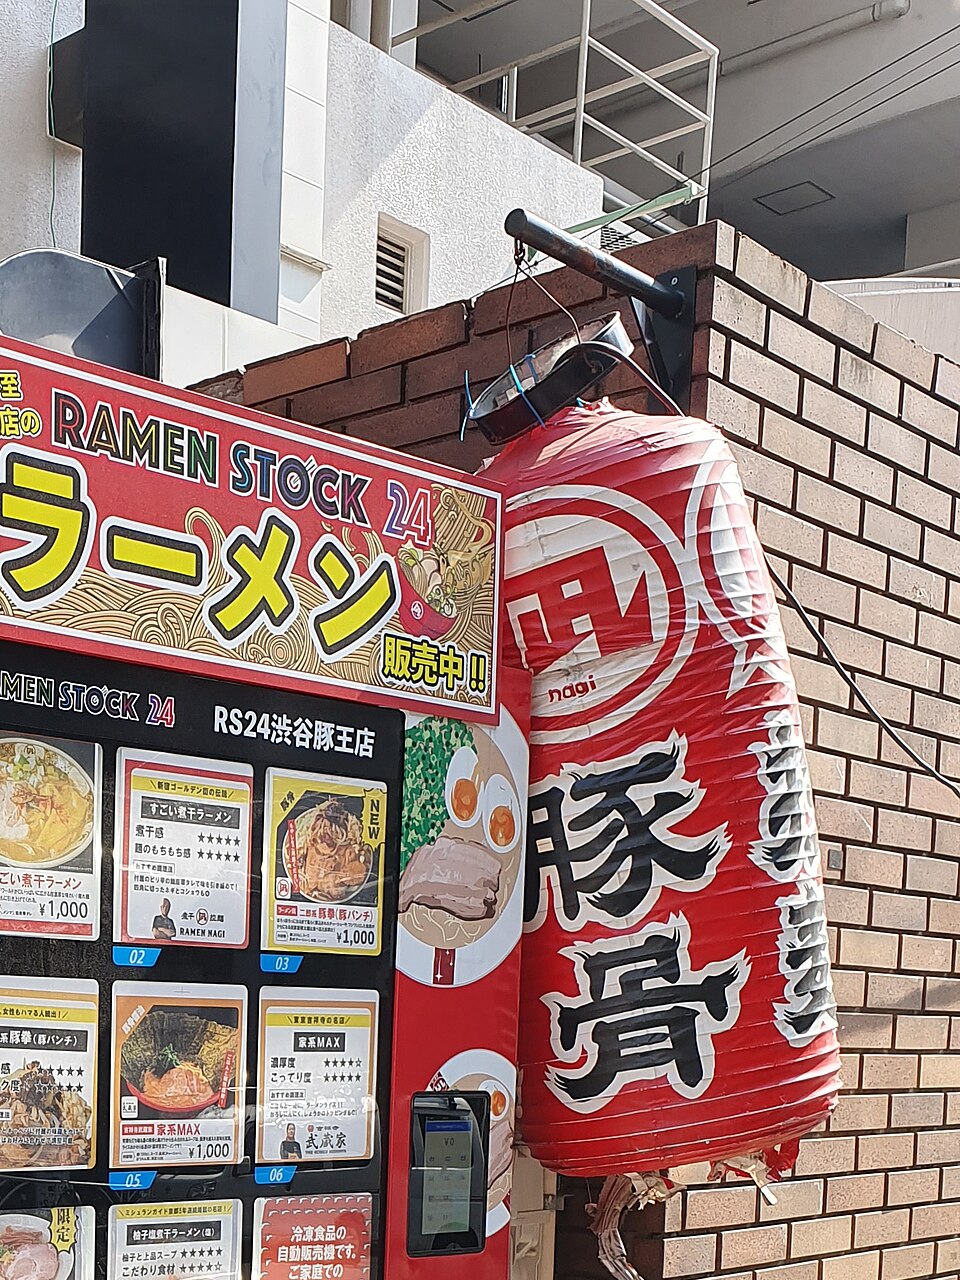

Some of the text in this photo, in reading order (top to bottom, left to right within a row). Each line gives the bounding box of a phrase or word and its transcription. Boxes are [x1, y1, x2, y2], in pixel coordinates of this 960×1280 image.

[52, 387, 433, 547] RAMEN STOCK 24
[547, 675, 597, 703] nagi
[58, 682, 141, 722] STOCK
[145, 694, 176, 728] 24
[214, 705, 377, 759] RS24渋谷豚王店
[149, 802, 232, 823] すごい煮干ラーメン
[368, 799, 381, 840] NEW
[135, 824, 164, 839] 煮干感
[39, 900, 88, 919] ¥1,000
[179, 927, 226, 939] RAMEN NAGI
[336, 929, 375, 947] ¥1,000
[129, 949, 146, 964] 02
[275, 956, 290, 971] 03
[298, 1036, 341, 1048] 家系MAX
[270, 1056, 296, 1069] 濃厚度
[270, 1072, 312, 1084] こってり度
[156, 1123, 201, 1136] 家系MAX
[305, 1132, 347, 1150] 武蔵家
[188, 1143, 230, 1160] ¥1,000
[125, 1173, 141, 1188] 05
[269, 1167, 283, 1182] 06
[55, 1207, 71, 1243] 限定
[290, 1225, 347, 1242] 冷凍食品の
[277, 1243, 356, 1262] 自動販売機です。
[122, 1263, 176, 1278] こだわり食材
[288, 1264, 344, 1280] ご家庭での
